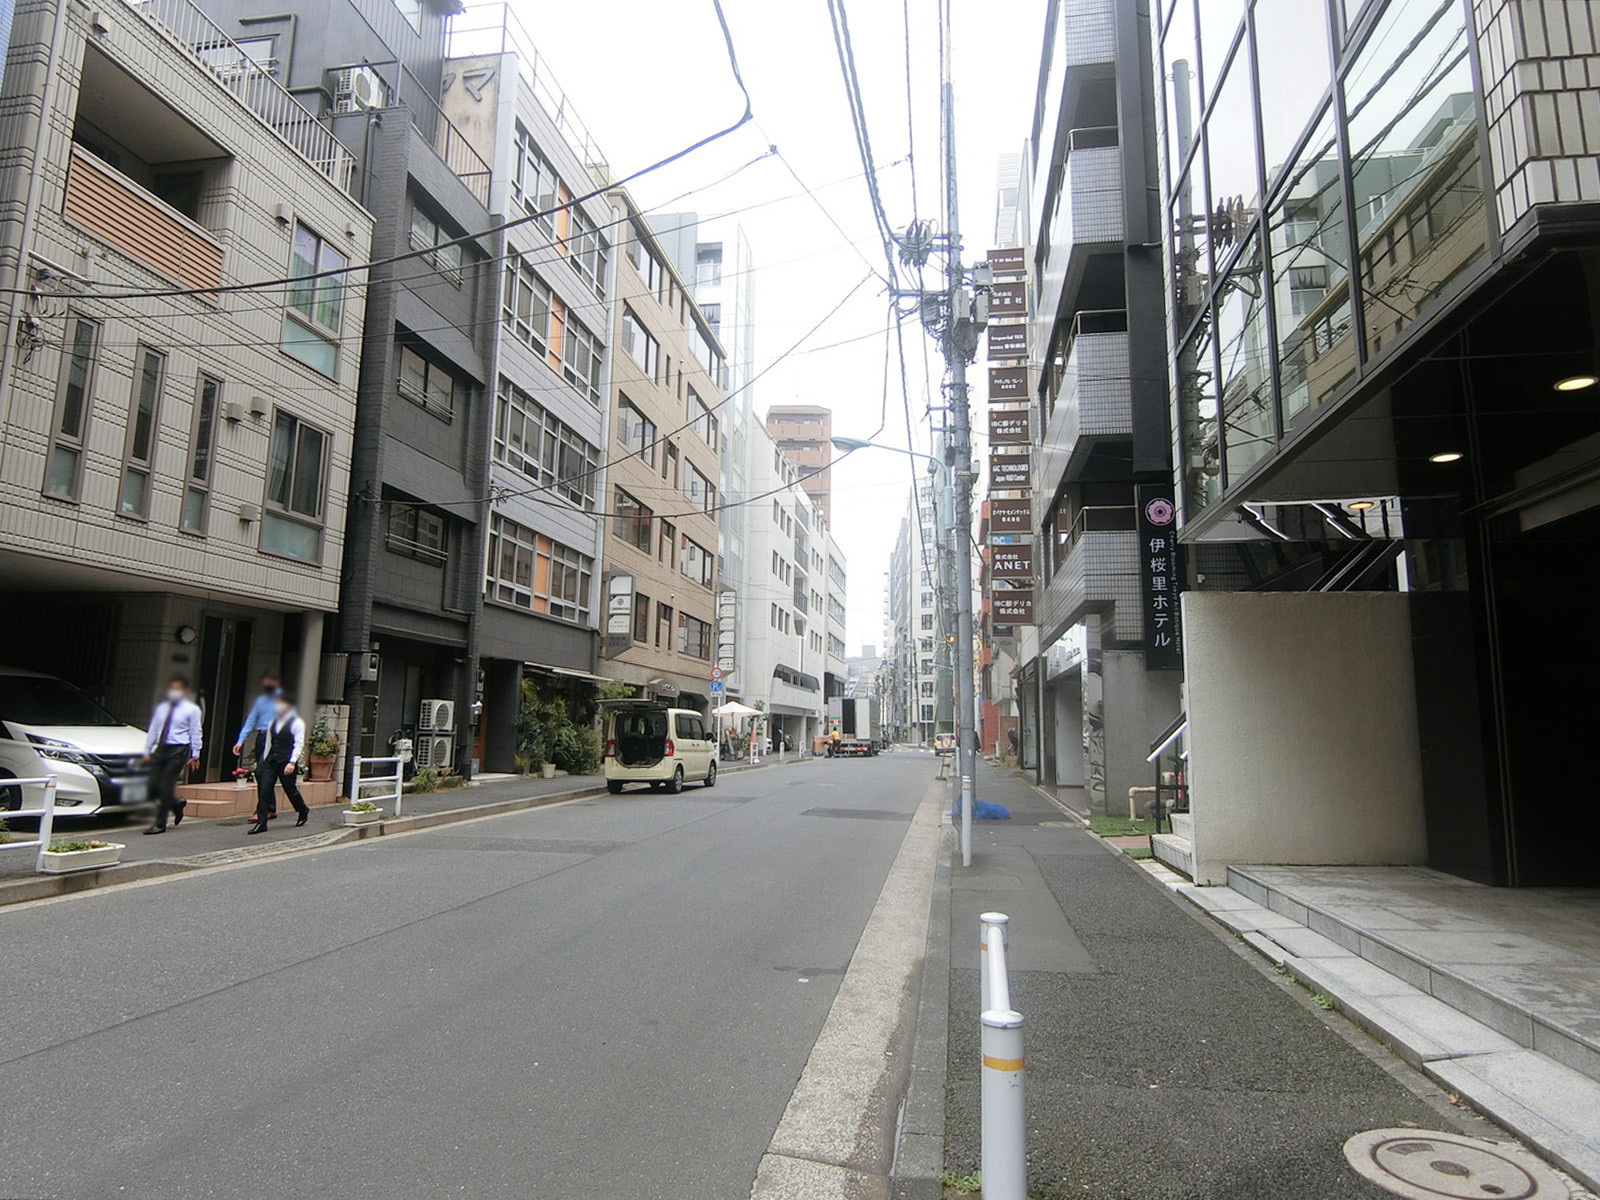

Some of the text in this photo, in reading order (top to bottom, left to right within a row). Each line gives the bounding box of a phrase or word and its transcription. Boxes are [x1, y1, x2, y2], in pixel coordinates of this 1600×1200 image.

[994, 560, 1031, 570] ANET
[998, 607, 1026, 615] 株式会社
[1149, 538, 1170, 647] 伊桜里ホテル
[1170, 581, 1178, 600] Tokyo
[1174, 636, 1182, 654] Hotel
